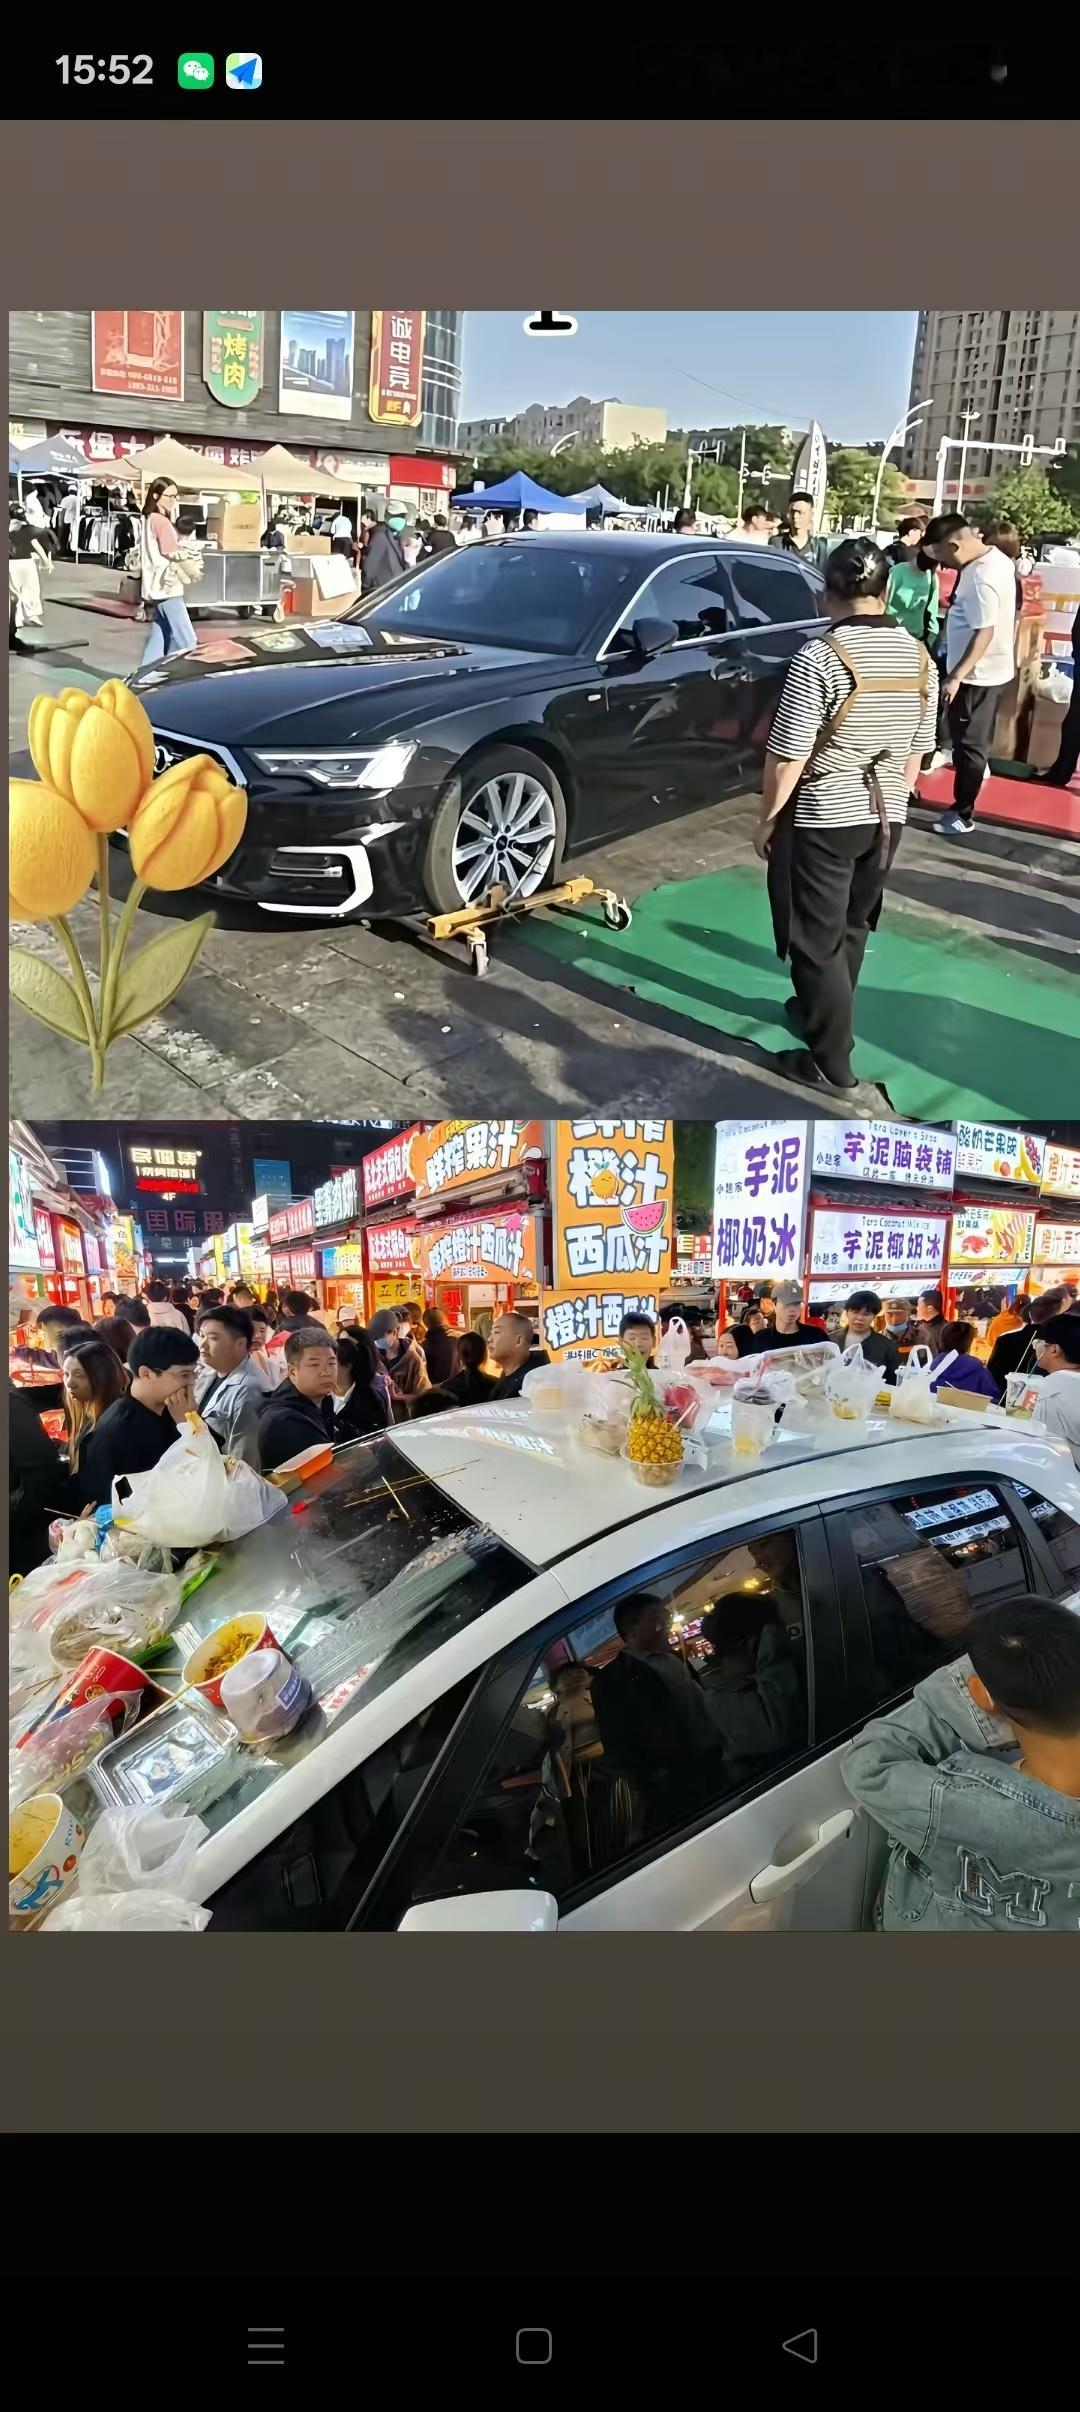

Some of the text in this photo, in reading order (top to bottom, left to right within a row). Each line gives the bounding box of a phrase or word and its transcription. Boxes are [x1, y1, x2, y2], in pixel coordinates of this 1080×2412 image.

[222, 332, 248, 391] 烤肉
[390, 311, 412, 390] 诚电竞
[426, 1120, 518, 1194] 鲜榨果汁
[568, 1147, 669, 1209] 橙汁
[744, 1136, 801, 1198] 芋泥
[843, 1131, 953, 1176] 芋泥脑袋铺
[428, 1223, 524, 1280] 鲜榨橙汁西瓜汁
[565, 1223, 669, 1277] 西瓜汁
[716, 1213, 797, 1267] 椰奶冰
[843, 1229, 941, 1260] 芋泥椰奶冰
[956, 1844, 1052, 1928] M
